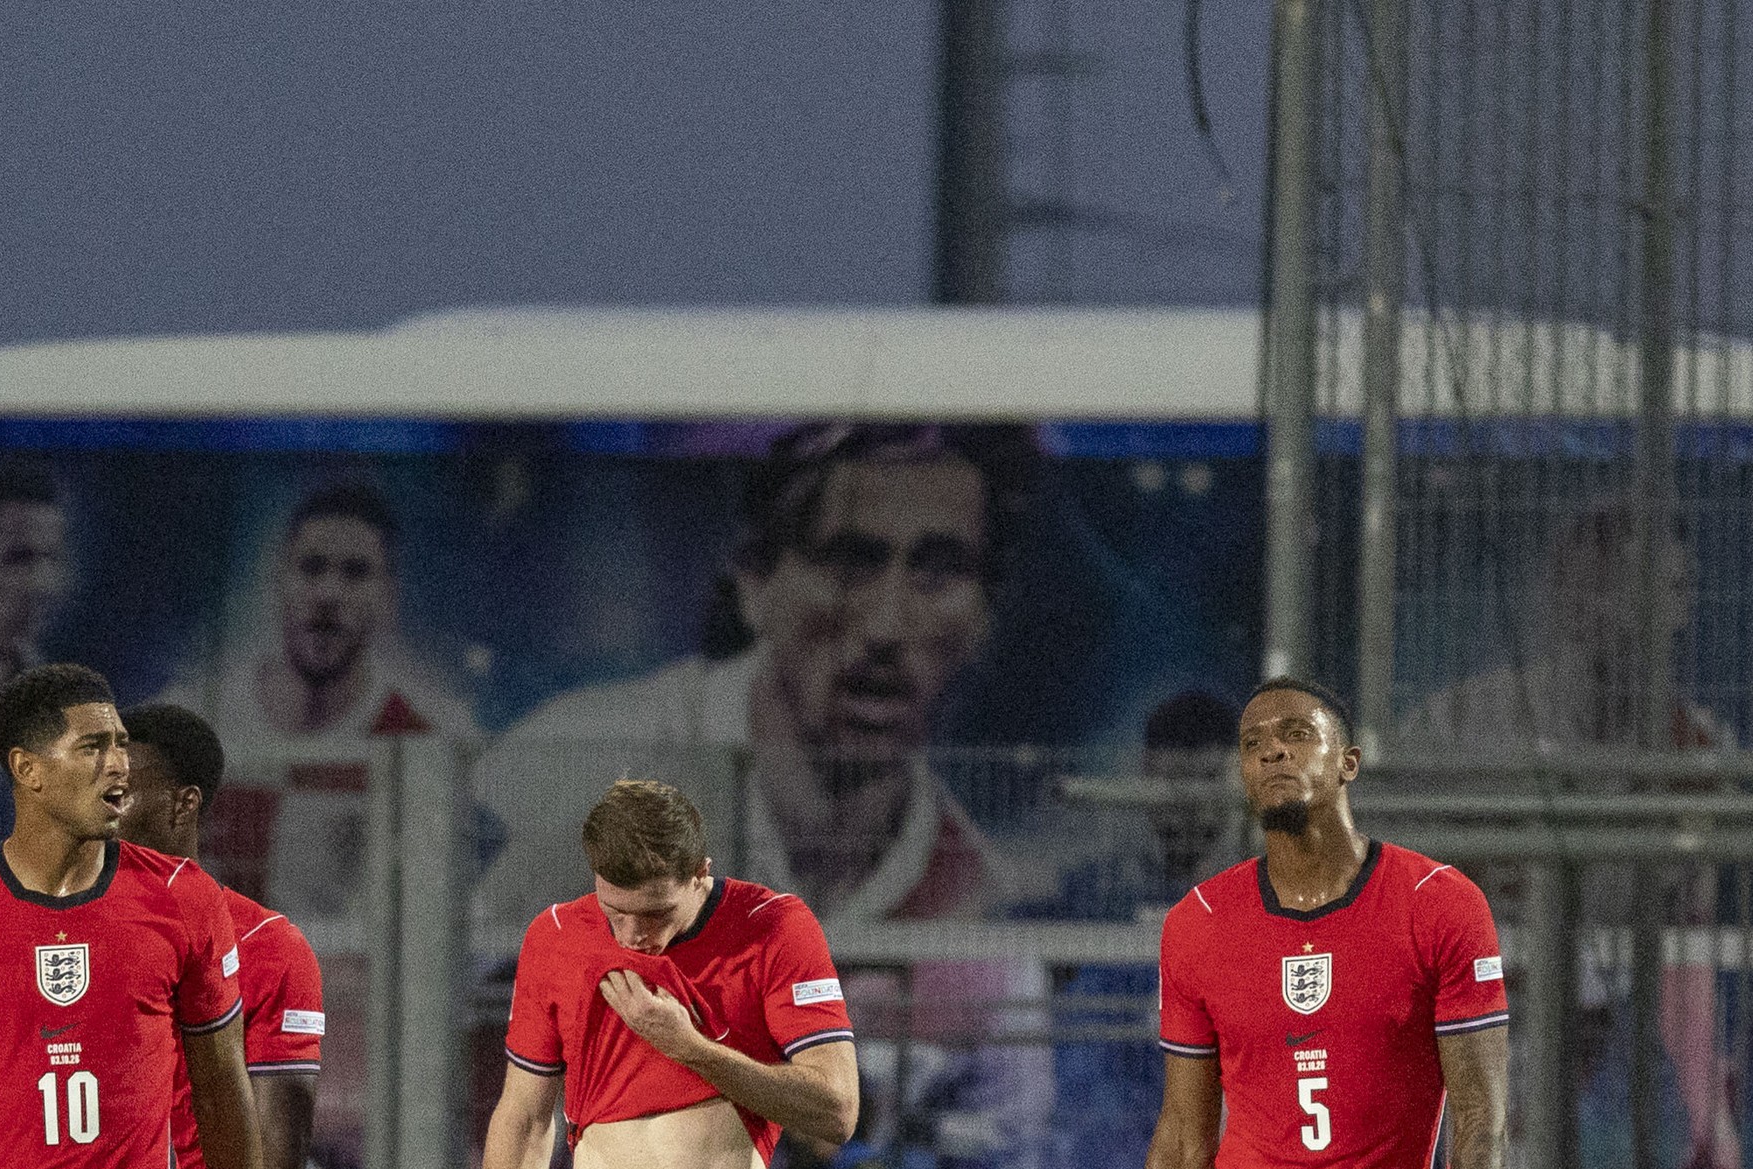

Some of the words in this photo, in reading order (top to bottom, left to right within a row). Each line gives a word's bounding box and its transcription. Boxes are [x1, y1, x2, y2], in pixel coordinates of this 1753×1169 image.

[47, 1042, 83, 1054] CROATIA
[1294, 1049, 1328, 1061] CROATIA
[38, 1070, 100, 1146] 10
[1298, 1077, 1332, 1151] 5
